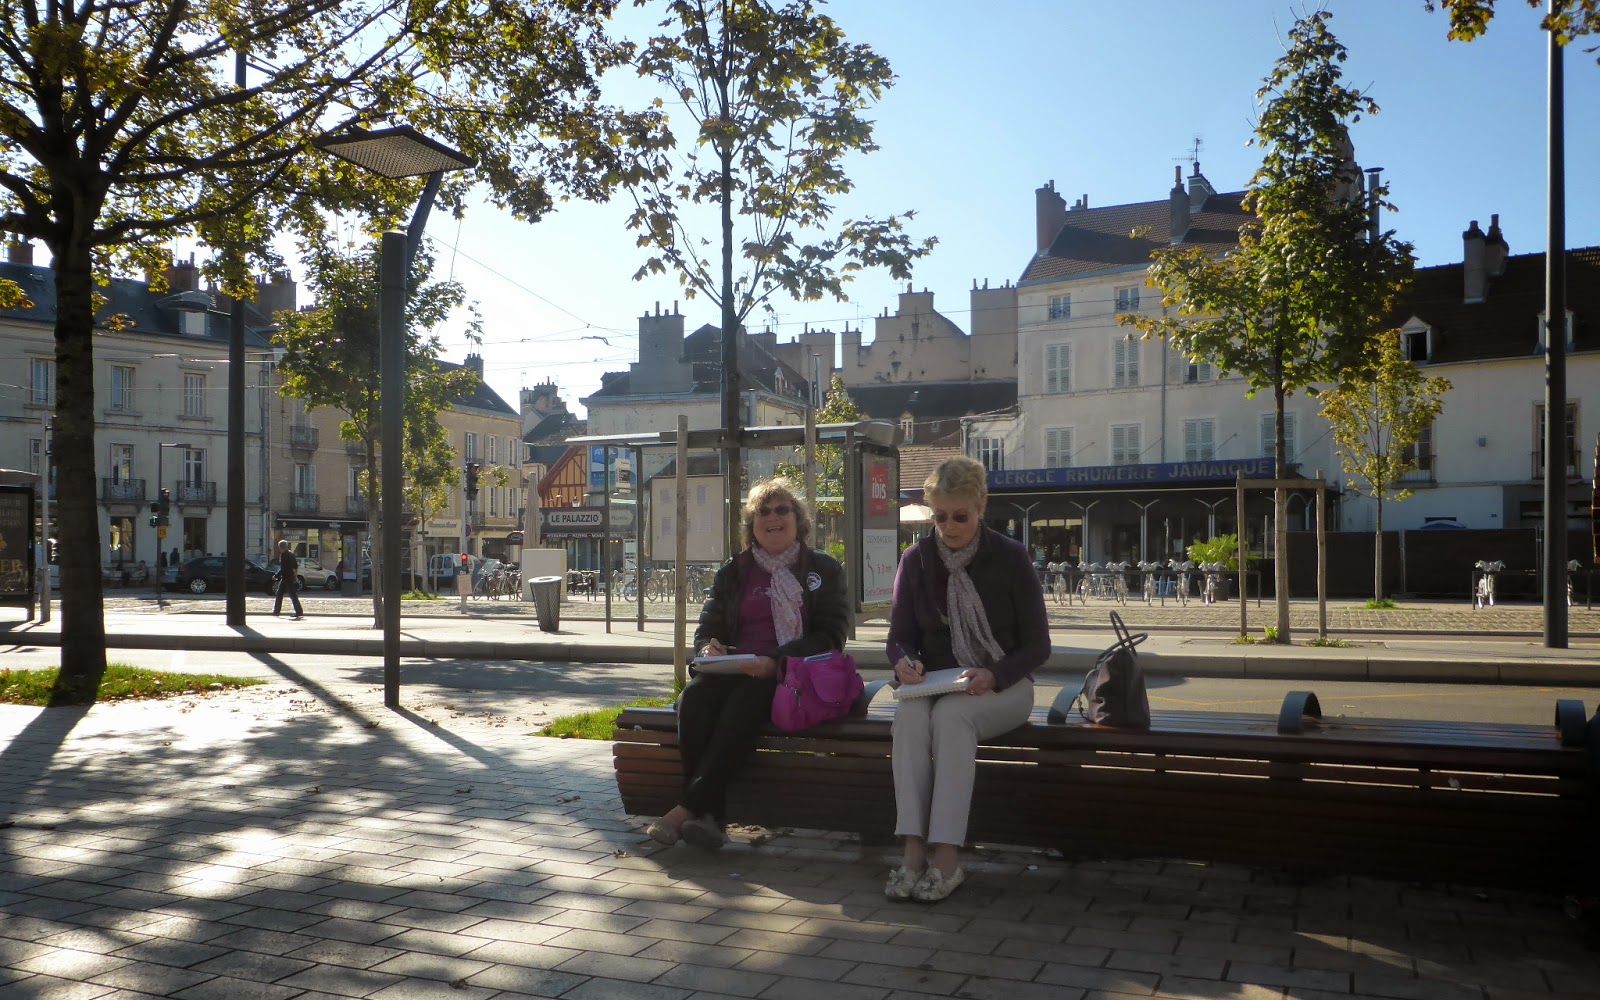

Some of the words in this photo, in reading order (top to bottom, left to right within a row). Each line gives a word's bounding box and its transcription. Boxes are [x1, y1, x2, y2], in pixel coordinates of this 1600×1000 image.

[994, 470, 1056, 485] CERCLE
[1065, 466, 1158, 482] RHUMERIE
[872, 477, 886, 499] ibis
[551, 514, 560, 522] LE
[562, 514, 599, 523] PALAZZIO
